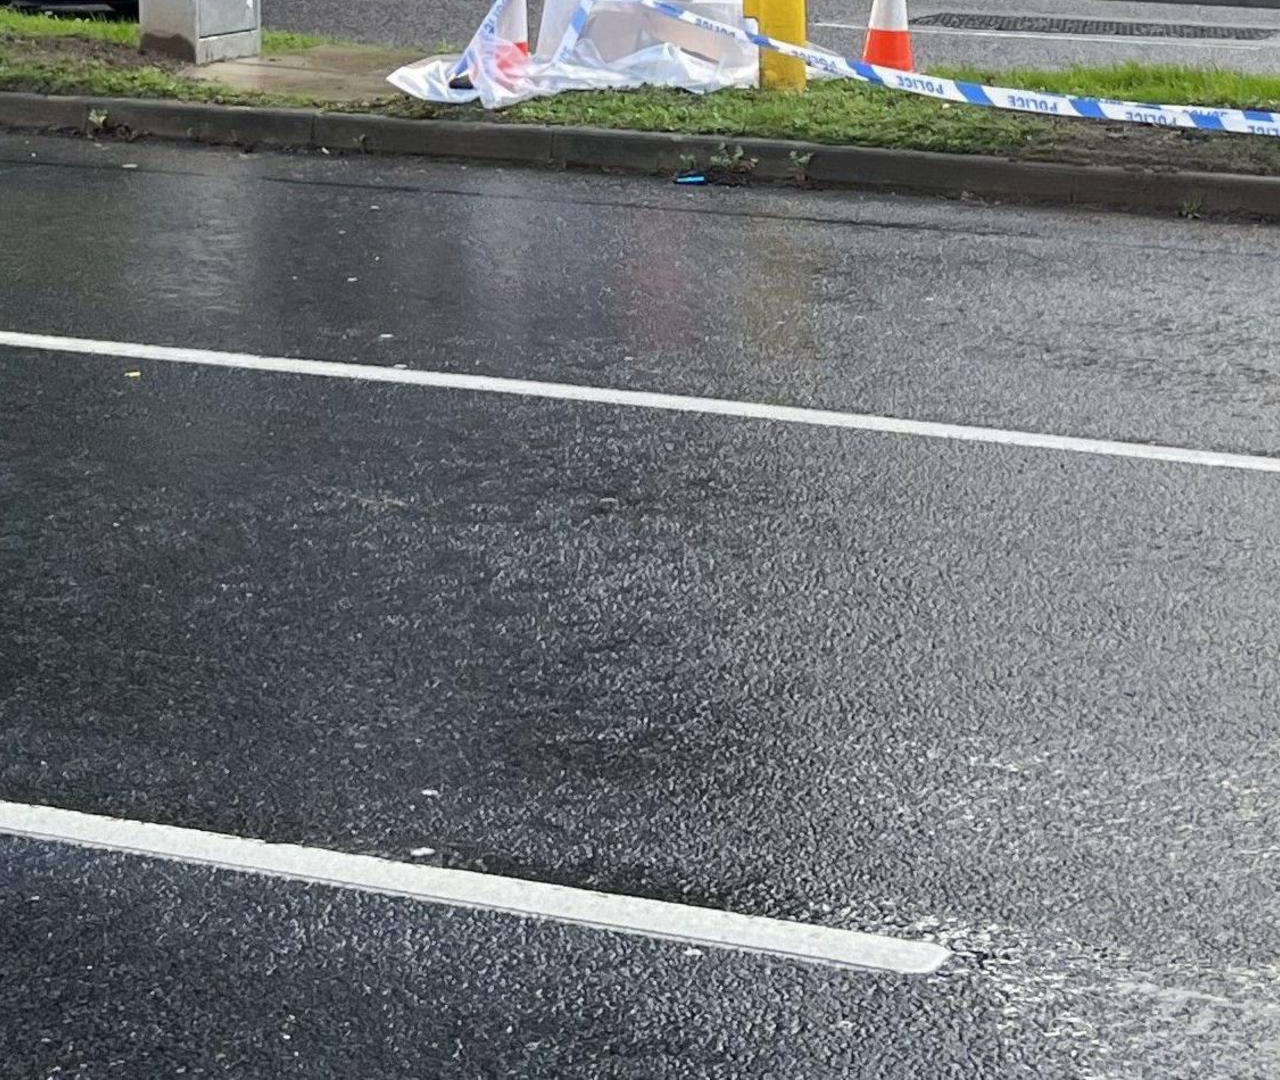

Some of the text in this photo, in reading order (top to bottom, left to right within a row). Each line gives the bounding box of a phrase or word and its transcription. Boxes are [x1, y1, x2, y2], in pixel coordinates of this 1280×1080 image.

[896, 75, 944, 95] POLICE
[1007, 95, 1059, 113] POLICE
[1126, 111, 1177, 126] POLICE
